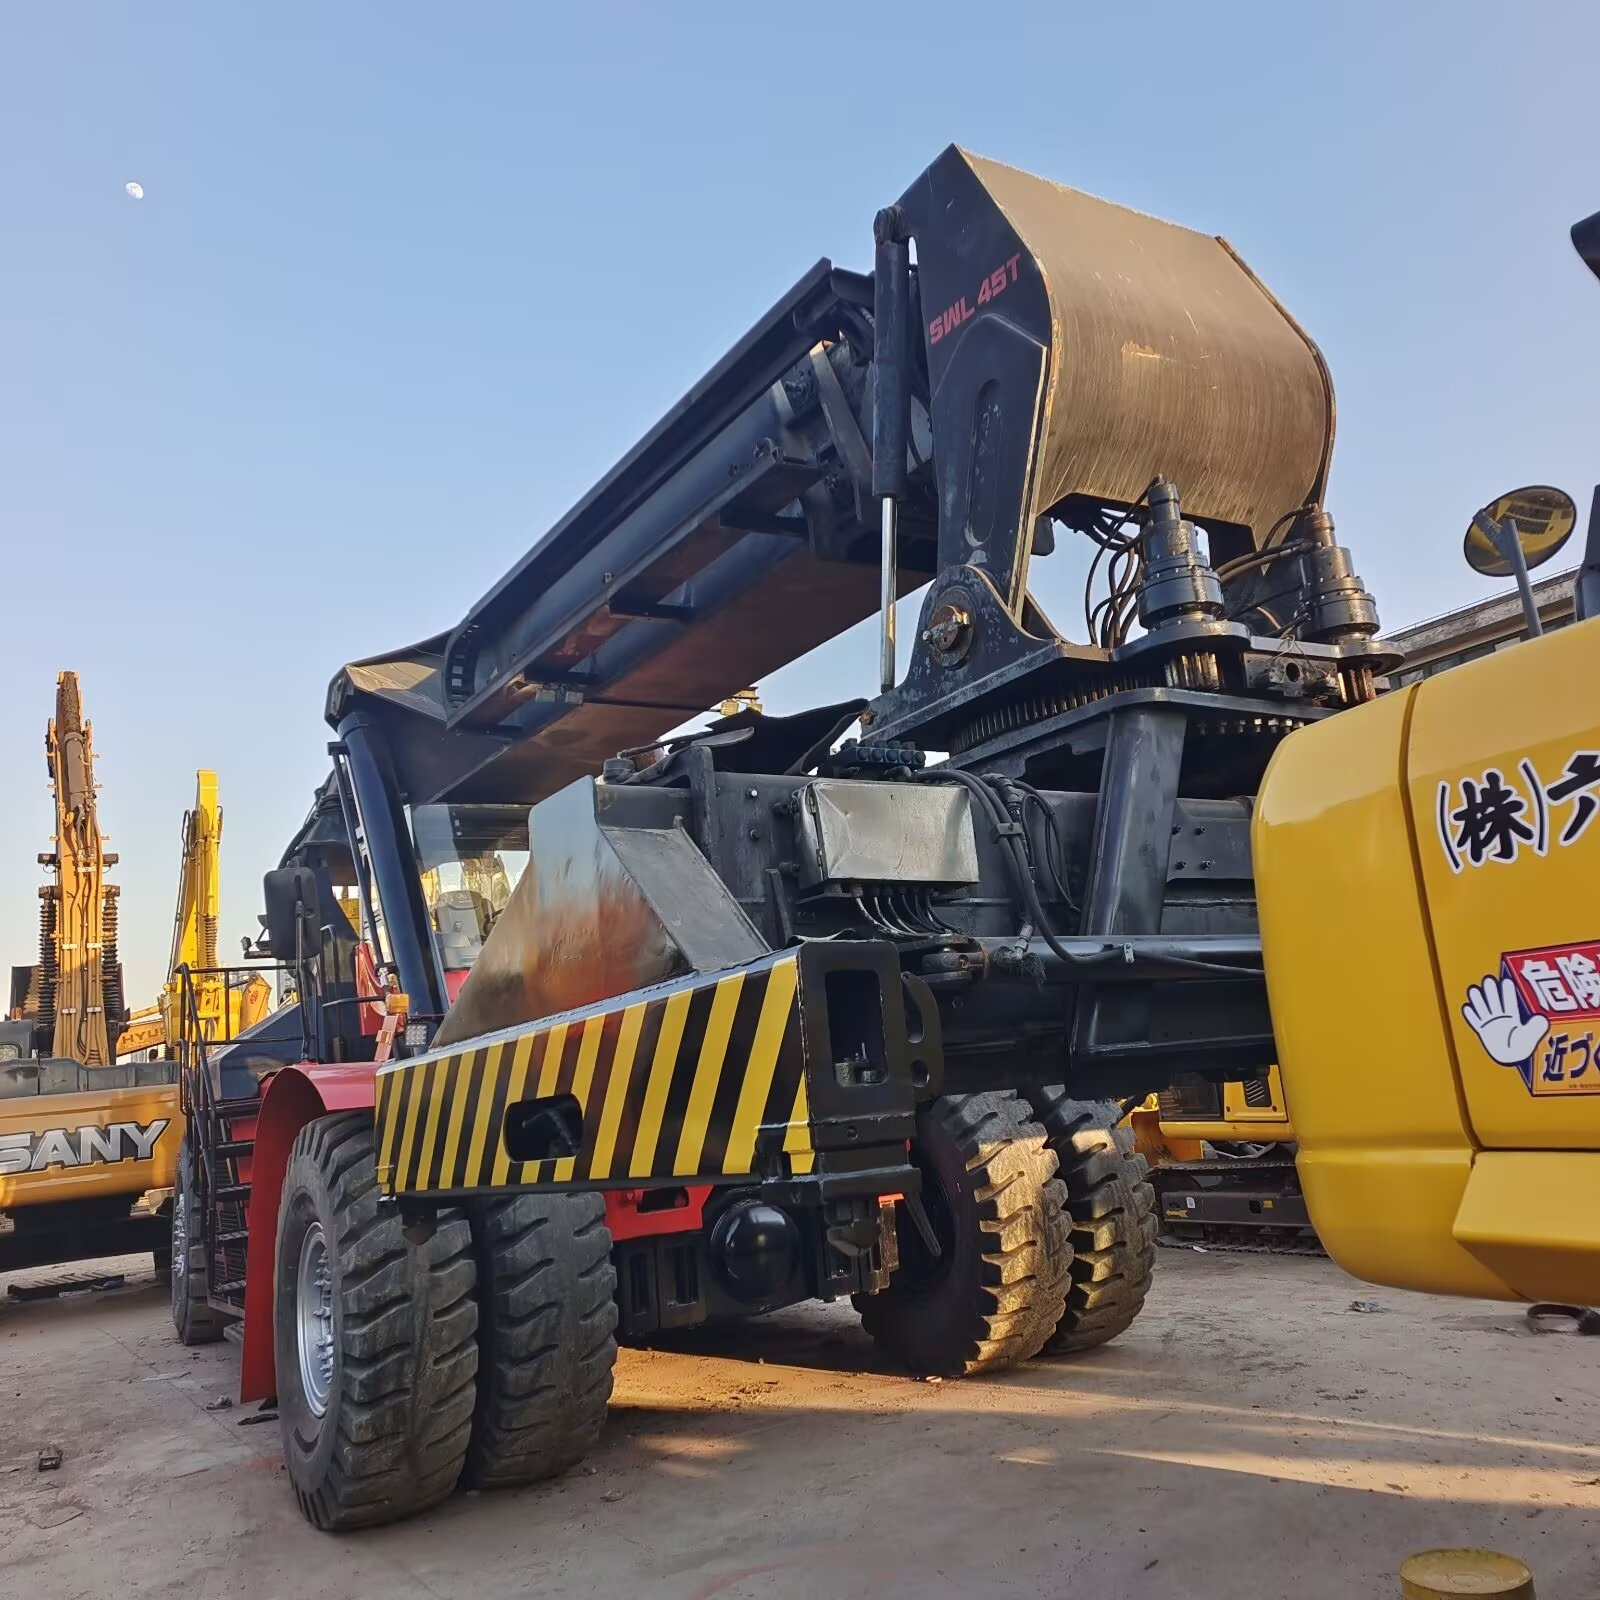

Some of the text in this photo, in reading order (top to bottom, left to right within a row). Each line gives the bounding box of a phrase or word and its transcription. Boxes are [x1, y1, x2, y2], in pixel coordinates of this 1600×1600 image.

[929, 252, 1021, 345] SWL 45T
[1520, 952, 1600, 1012] 危険
[0, 1119, 170, 1174] SANY
